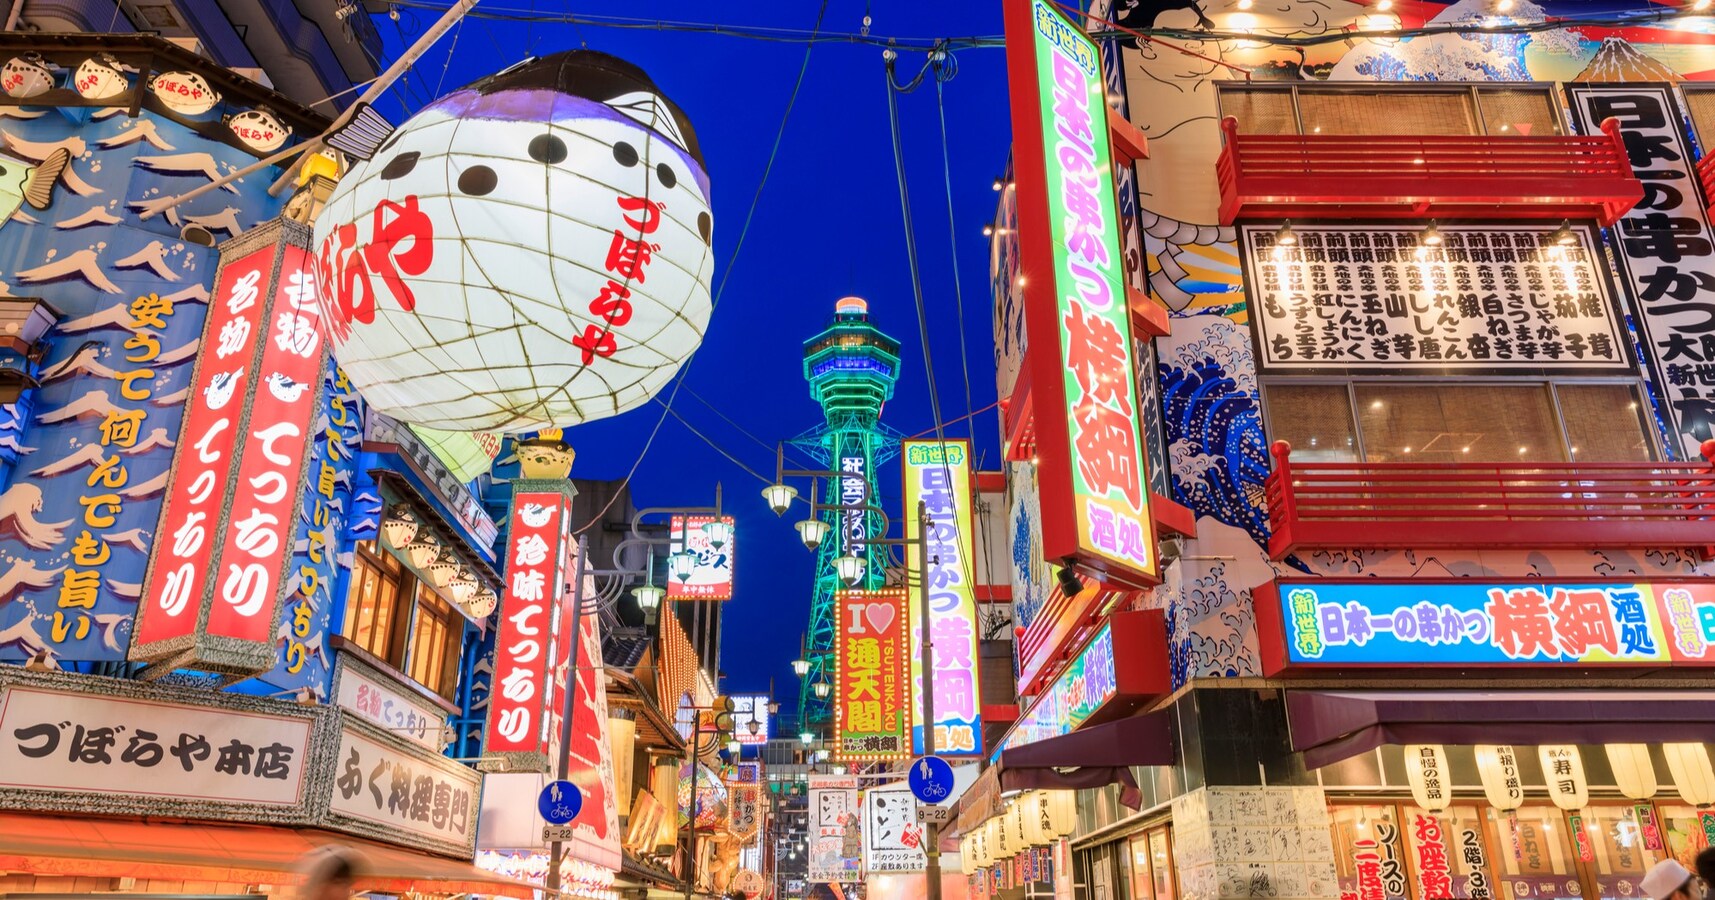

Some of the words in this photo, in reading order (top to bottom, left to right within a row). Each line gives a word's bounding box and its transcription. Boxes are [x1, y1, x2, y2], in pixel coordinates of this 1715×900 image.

[1036, 3, 1096, 77] 新世界
[1052, 47, 1112, 311] 日本一の串かつ
[572, 195, 667, 367] づぼらや
[1254, 232, 1277, 263] 前頭
[1280, 232, 1303, 263] 頭
[1301, 232, 1327, 263] 前頭
[1325, 232, 1351, 263] 前頭
[1348, 232, 1374, 263] 前頭
[1372, 232, 1398, 263] 前頭
[1395, 232, 1422, 263] 前頭
[1420, 232, 1446, 263] 頭
[1444, 232, 1470, 263] 前頭
[216, 269, 261, 360] 名物
[1264, 293, 1293, 360] もち
[1289, 293, 1320, 360] うずら玉子
[1311, 293, 1345, 360] 紅しょうが
[1335, 293, 1366, 360] にんにく
[1360, 293, 1392, 360] 玉ねぎ
[1384, 293, 1417, 360] 山芋
[1408, 293, 1442, 360] しし唐
[1432, 293, 1468, 360] れんこん
[1456, 293, 1491, 360] 銀杏
[1466, 232, 1494, 263] 前頭
[1482, 293, 1514, 360] 白ねぎ
[1489, 232, 1517, 263] 前頭
[1506, 293, 1540, 360] さつま芋
[1513, 232, 1541, 263] 前頭
[1529, 293, 1565, 360] じゃが芋
[1536, 232, 1564, 263] 前頭
[1553, 293, 1588, 360] 茄子
[1562, 232, 1588, 263] 頭
[1577, 293, 1613, 360] 椎茸
[1065, 298, 1143, 513] 横綱
[51, 292, 174, 643] 安うて何んでも旨い
[908, 445, 963, 465] 新世界
[160, 417, 230, 617] てっちり
[222, 421, 300, 617] てっちり
[1090, 503, 1146, 564] 酒処
[497, 533, 549, 743] 珍味てっちり
[847, 603, 866, 634] I
[1293, 591, 1322, 656] 新世界
[1320, 604, 1487, 643] 日本一の串かつ
[1488, 590, 1618, 656] 横綱
[1609, 592, 1656, 655] 酒処
[1666, 591, 1703, 655] 新世界
[847, 637, 882, 733] 通天閣
[883, 637, 896, 731] TSUTENKAKU
[915, 616, 974, 721] 横綱
[356, 684, 427, 740] 名物てっちり
[864, 736, 898, 751] 横綱
[13, 720, 294, 780] づぼらや本店
[1420, 747, 1442, 799] 自慢の逸品
[1553, 760, 1577, 795] 寿司
[337, 746, 469, 835] ふぐ料理専門
[917, 809, 947, 820] 9-22
[543, 829, 571, 839] 9-22
[1376, 823, 1402, 894] ソースの
